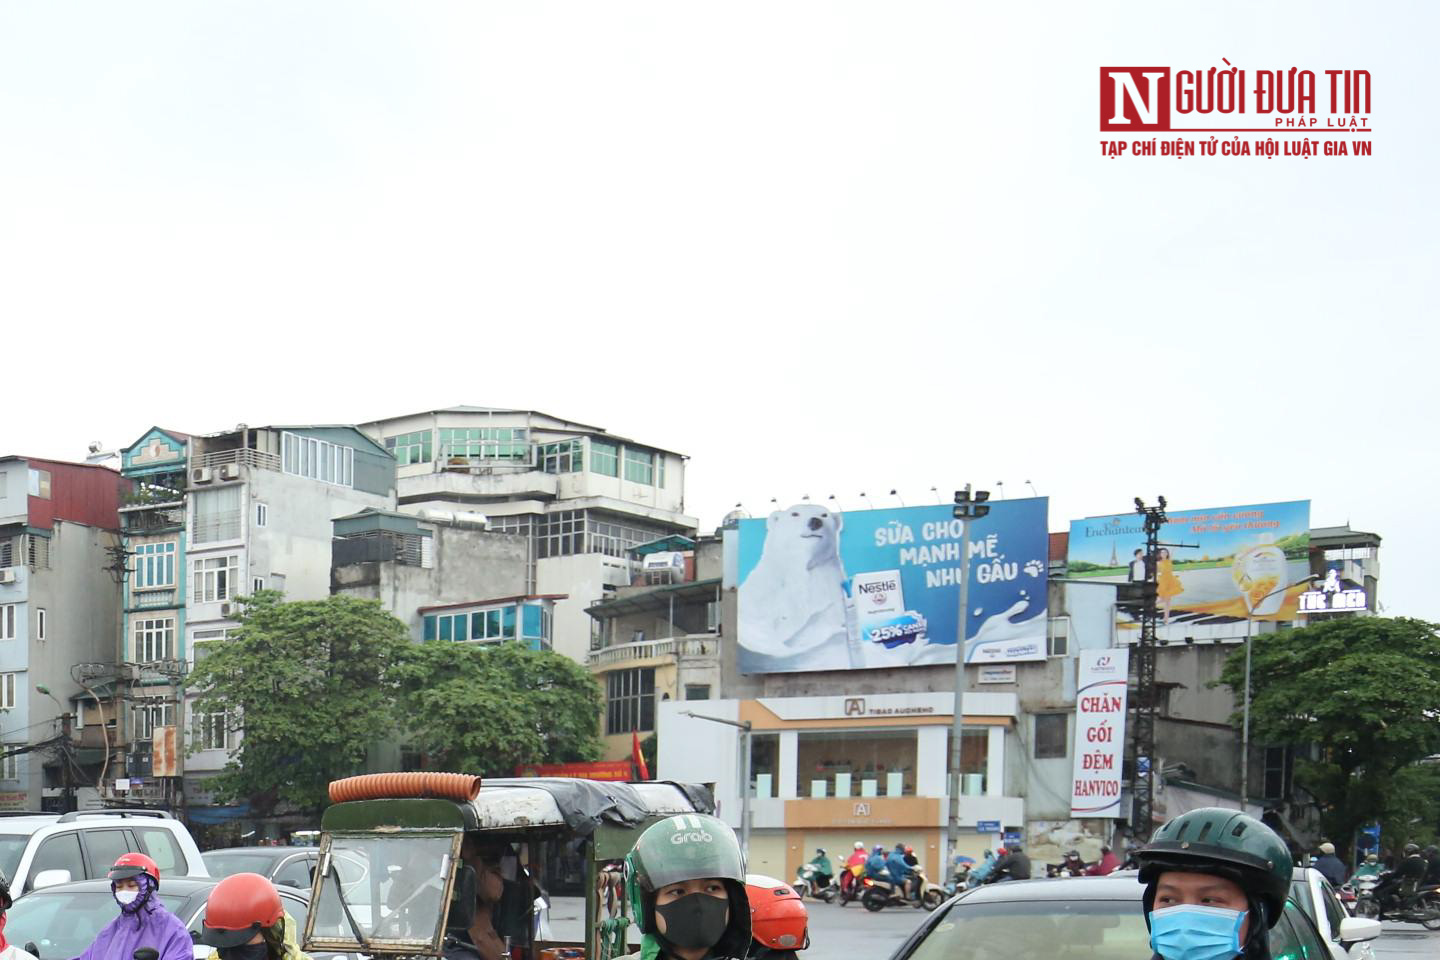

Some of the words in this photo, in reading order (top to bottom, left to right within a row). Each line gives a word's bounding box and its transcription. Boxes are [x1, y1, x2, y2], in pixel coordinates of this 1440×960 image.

[875, 520, 914, 547] SỮA
[922, 519, 964, 542] CHO
[900, 542, 960, 567] MẠNH
[968, 533, 998, 559] MẼ
[977, 554, 1018, 584] GẤU
[872, 624, 903, 642] 25%
[1081, 692, 1122, 713] CHĂN
[1087, 719, 1113, 743] GỐI
[1082, 749, 1114, 774] ĐỆM
[1074, 780, 1119, 797] HANVICO
[671, 830, 712, 844] Grab
